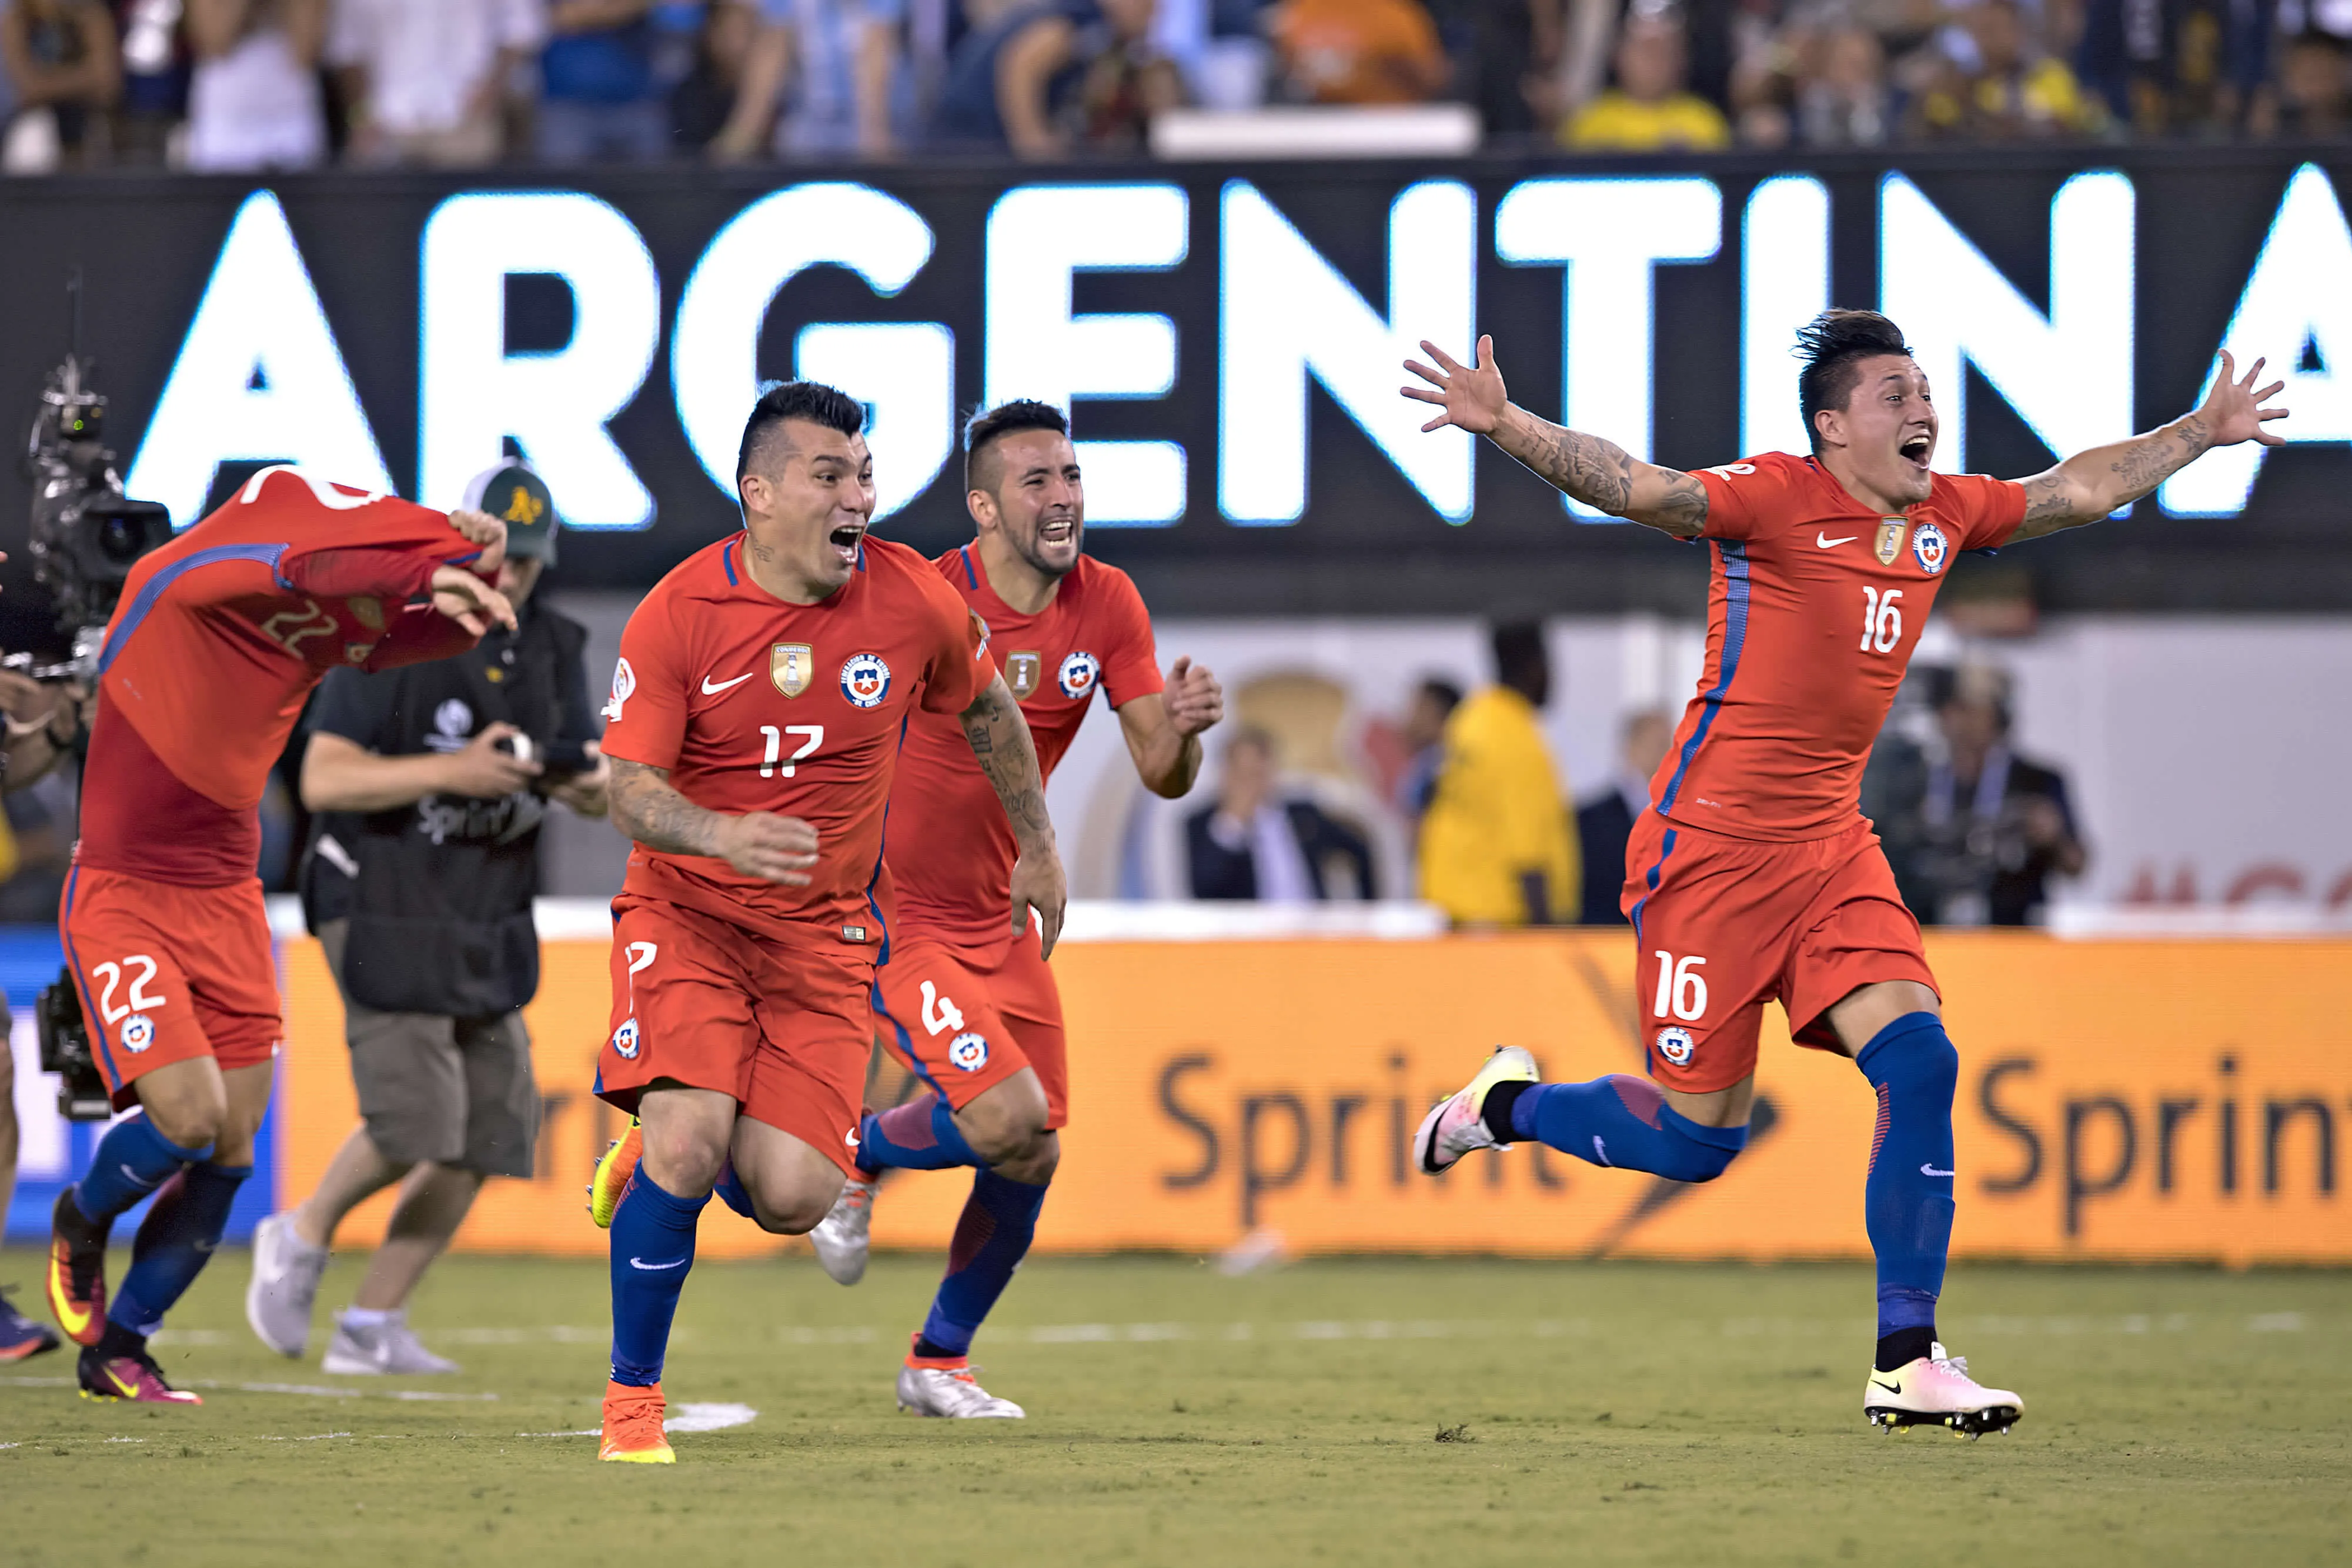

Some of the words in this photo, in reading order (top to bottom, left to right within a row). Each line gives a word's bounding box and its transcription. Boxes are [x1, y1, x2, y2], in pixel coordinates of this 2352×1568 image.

[122, 162, 2352, 531] ARGENTINA
[1860, 586, 1903, 653] 16
[760, 725, 824, 778] 17
[92, 955, 166, 1025] 22
[920, 980, 965, 1036] 4
[1653, 950, 1708, 1021] 16
[1157, 1052, 1566, 1230] Sprit
[1977, 1054, 2352, 1236] Sprin
